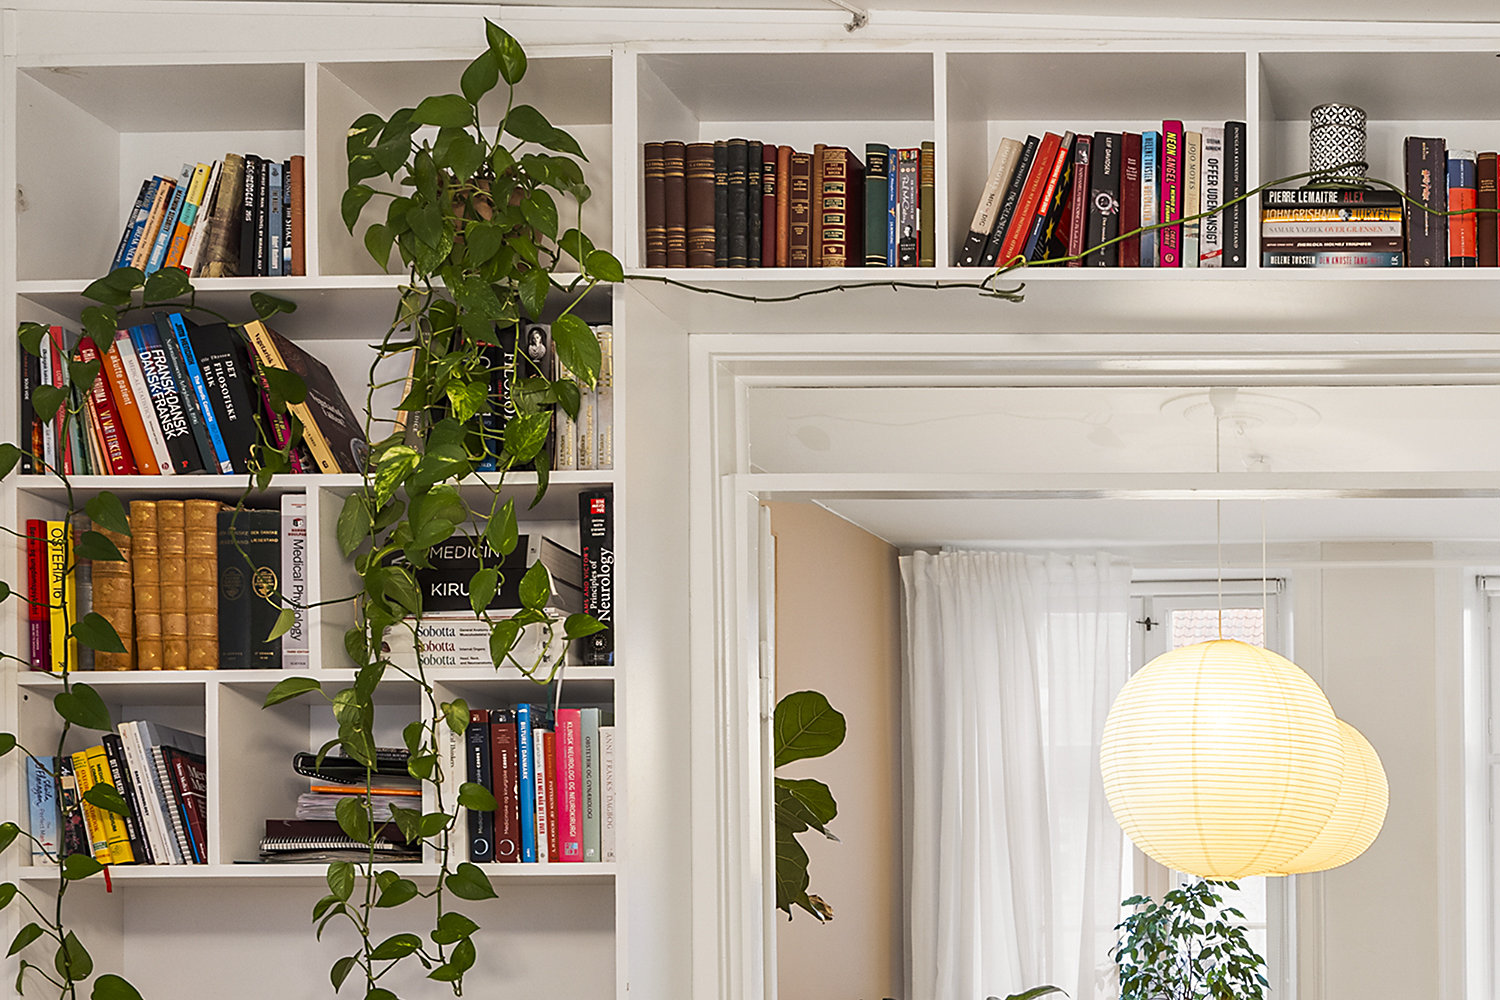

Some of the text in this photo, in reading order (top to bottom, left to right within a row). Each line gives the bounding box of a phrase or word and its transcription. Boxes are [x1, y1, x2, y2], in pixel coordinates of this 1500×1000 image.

[1104, 149, 1112, 175] DAVIDSEN
[1165, 131, 1177, 183] NEON ANGEL
[1188, 163, 1196, 190] MOYES
[1207, 158, 1218, 186] OFFER
[1207, 188, 1218, 211] UDEN
[1269, 191, 1365, 203] PIERRE LEMAITRE ALEX
[992, 191, 1017, 245] DRAGELØBEREN
[1266, 208, 1336, 219] JOHN GRISHAM
[1206, 216, 1217, 245] ANSIGT
[109, 355, 132, 406] akutte patient
[203, 365, 216, 387] BLIK
[225, 360, 237, 378] DET
[213, 362, 237, 421] FILOSOFISKE
[106, 435, 123, 462] FISKERE
[50, 527, 66, 584] OSTERIA
[430, 545, 500, 559] MEDICIN
[290, 538, 304, 641] Medical Physiology
[431, 582, 501, 597] KIRUI
[589, 560, 598, 610] Principles of
[598, 547, 614, 623] Neurology
[417, 625, 456, 637] Sobotta
[568, 781, 575, 790] OG
[585, 769, 592, 778] OG
[585, 779, 593, 819] GYNÆKOLOGI
